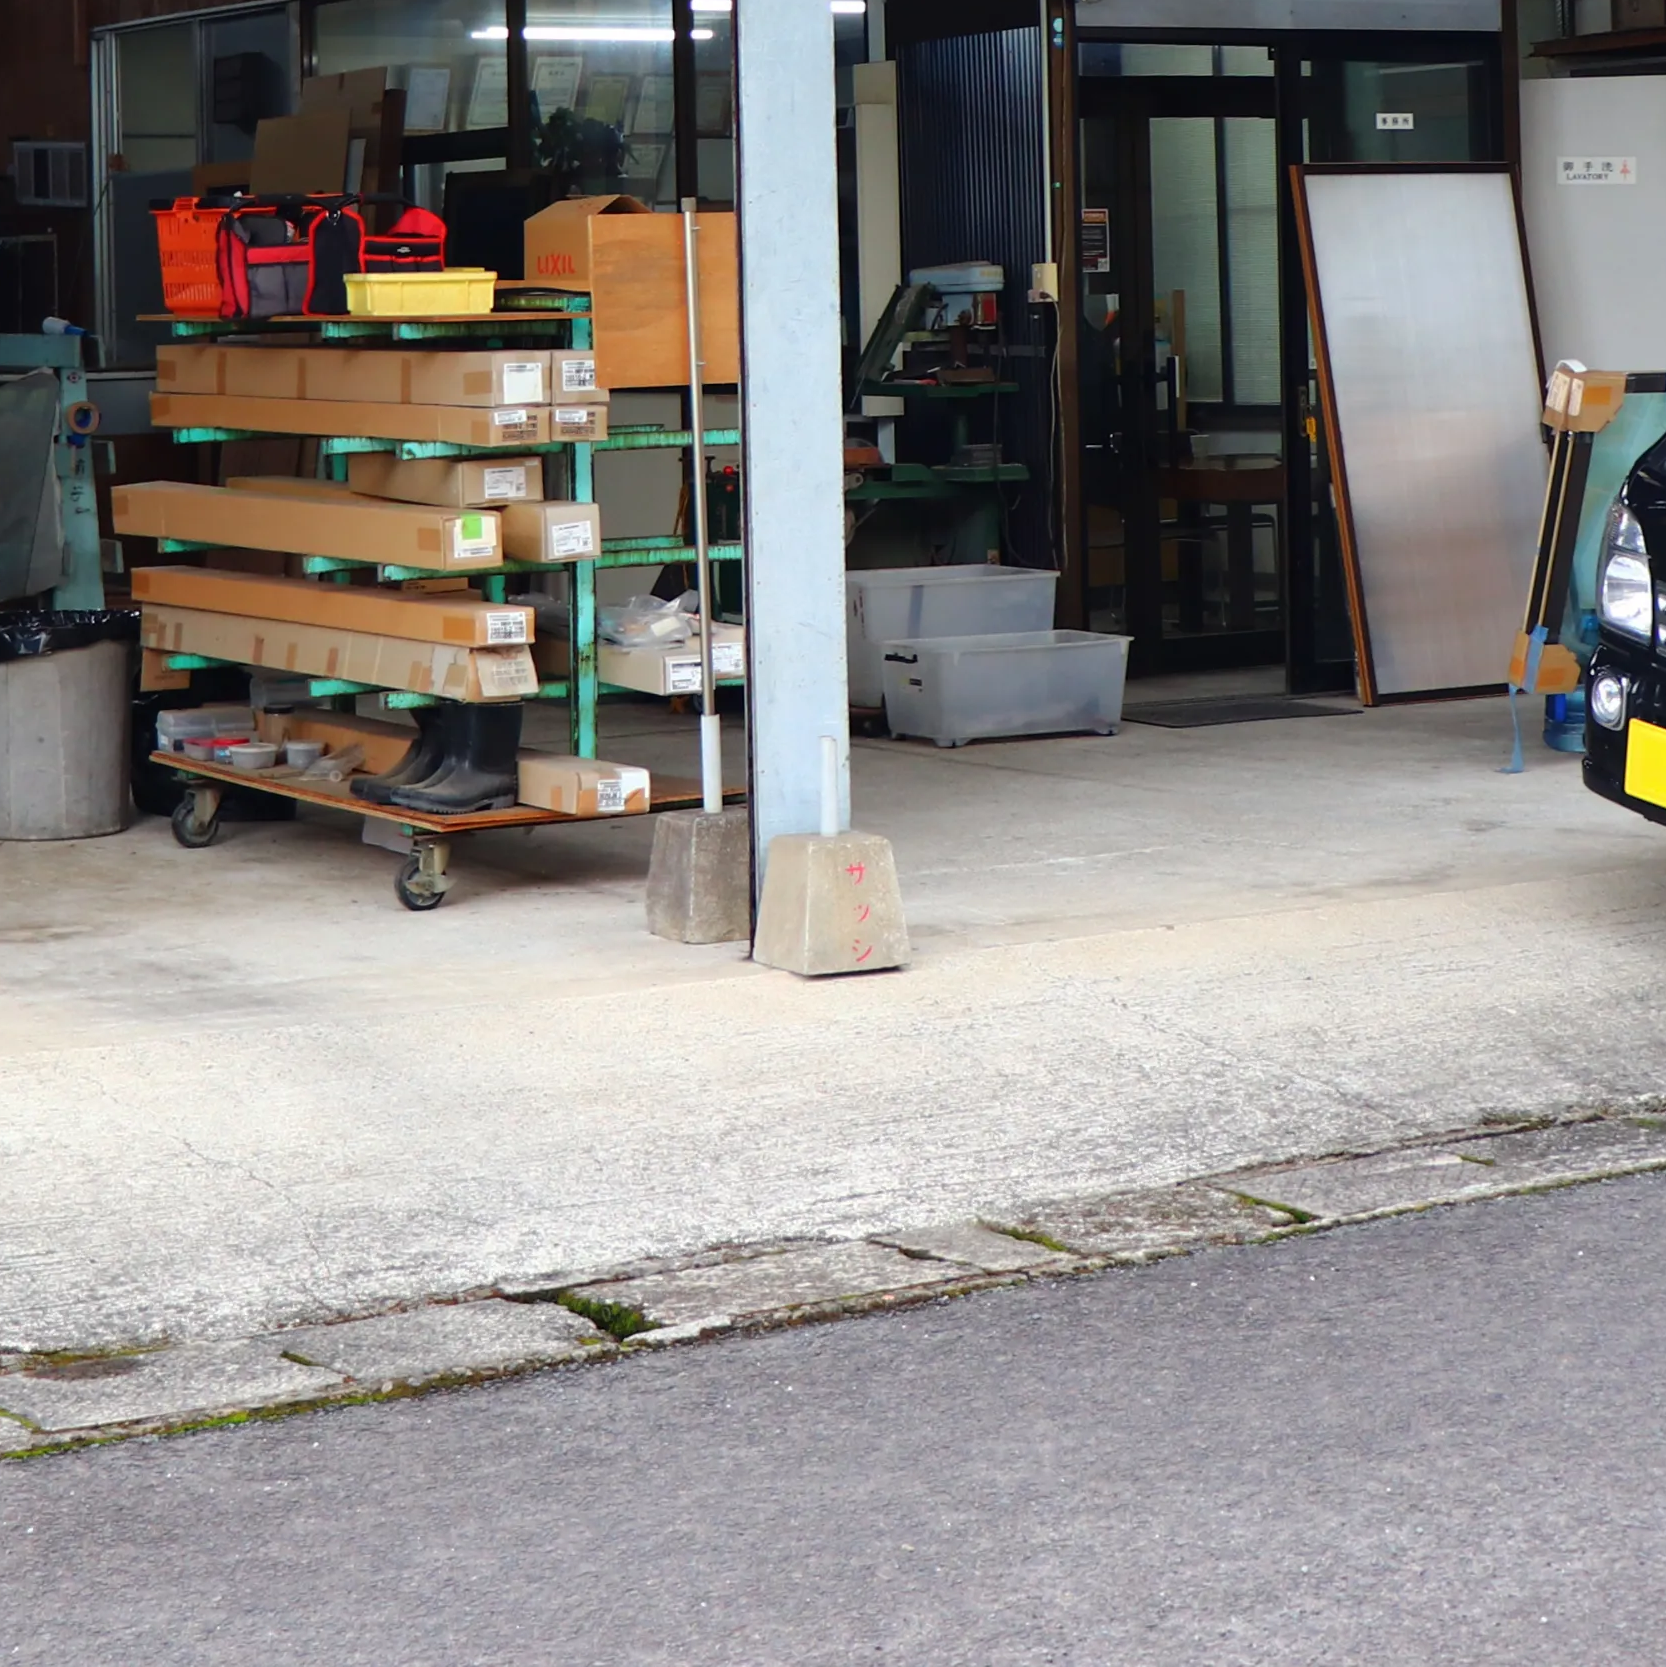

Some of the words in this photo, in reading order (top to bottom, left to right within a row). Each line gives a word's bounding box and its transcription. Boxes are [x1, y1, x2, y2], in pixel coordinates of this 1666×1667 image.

[1566, 173, 1610, 181] LAVATORY
[537, 252, 577, 276] LIXIL
[845, 861, 873, 963] サッシ
